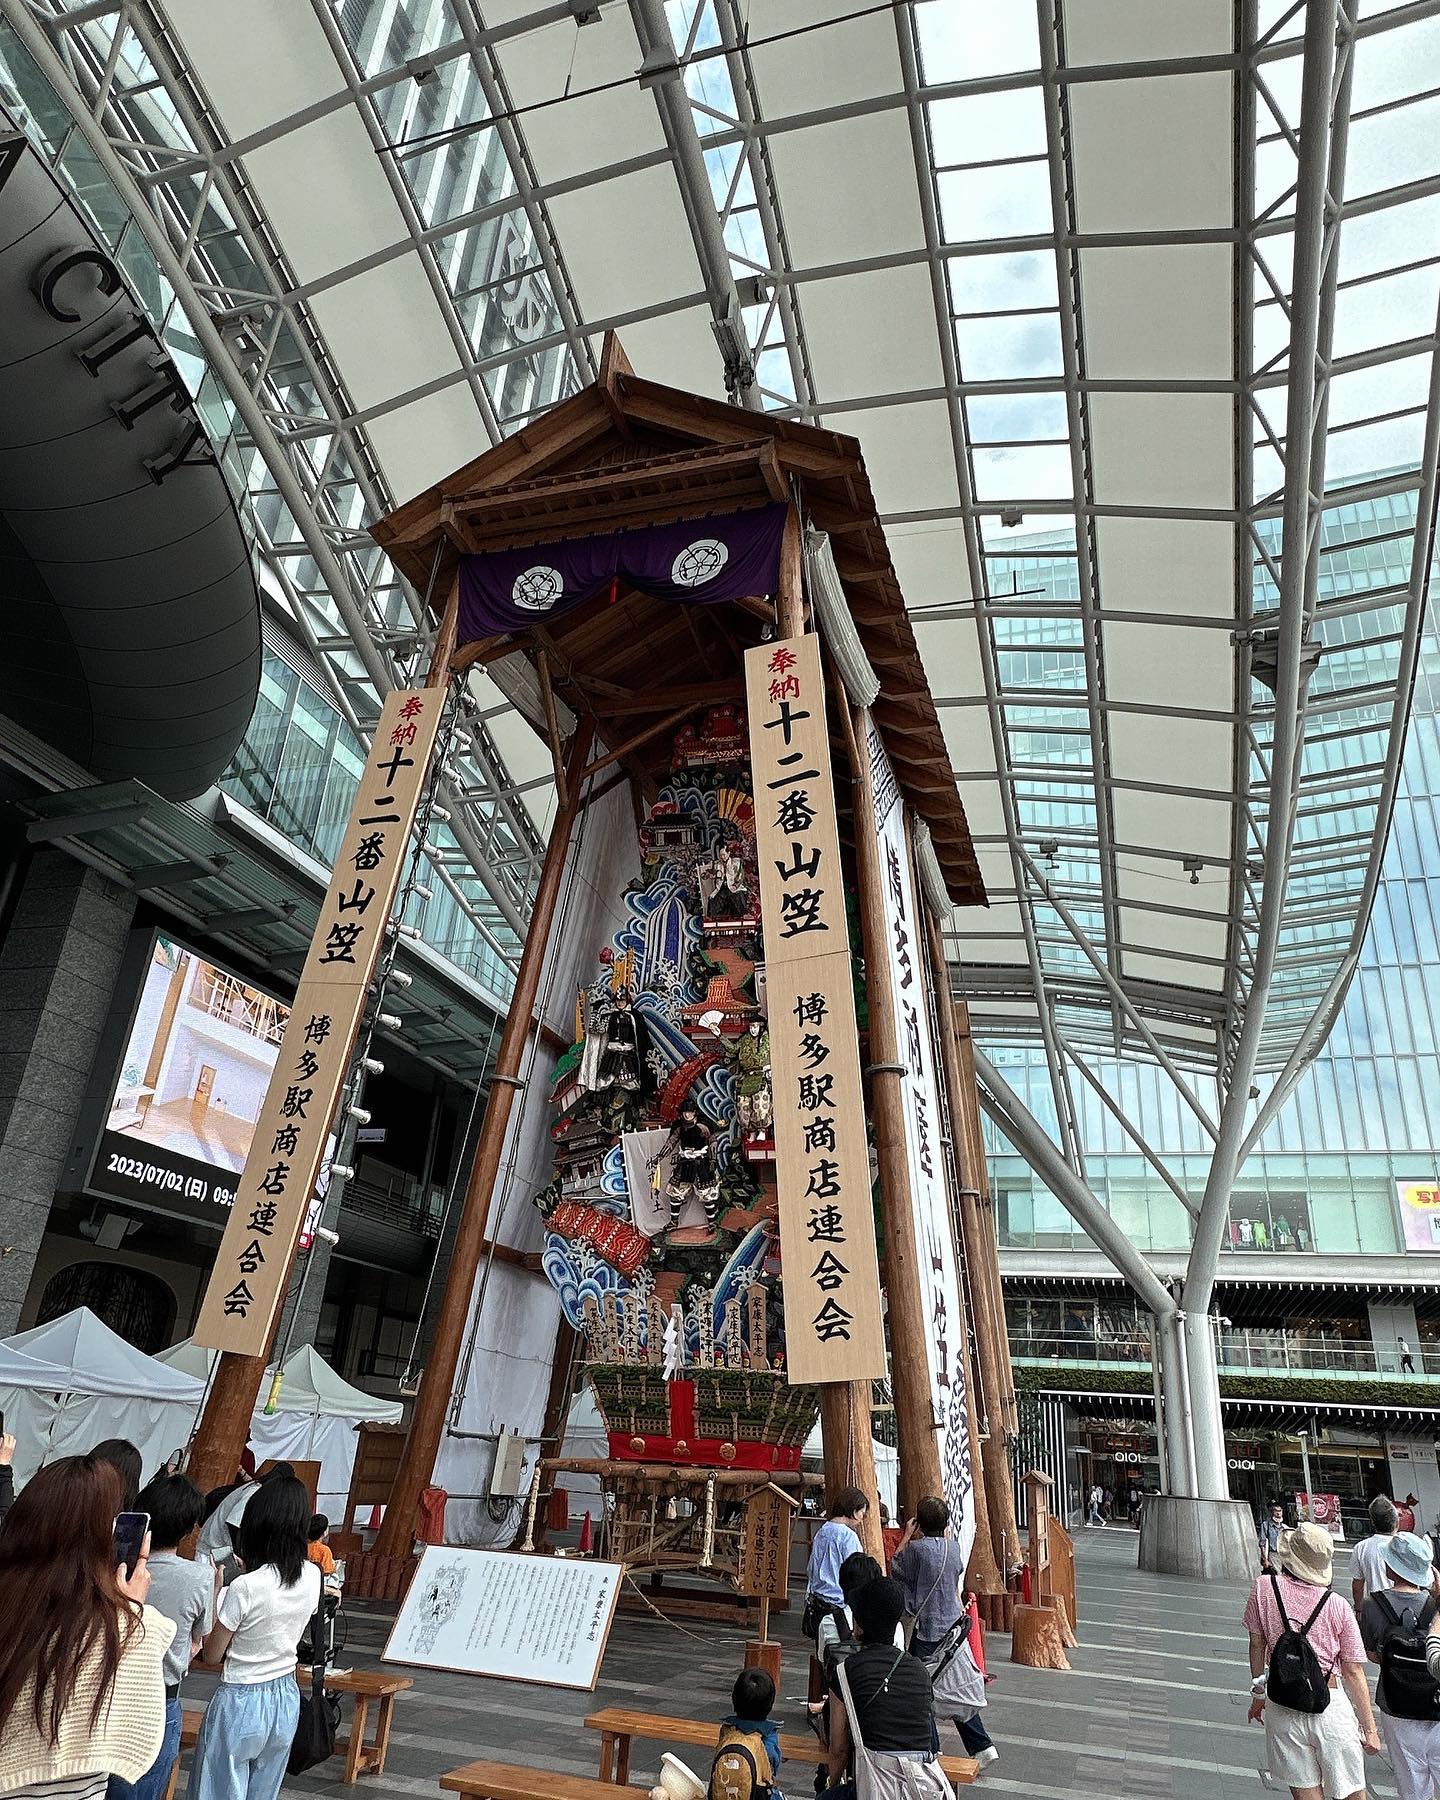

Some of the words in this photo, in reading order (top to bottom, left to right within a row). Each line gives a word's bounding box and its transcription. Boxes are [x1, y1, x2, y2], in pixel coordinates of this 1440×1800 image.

[31, 246, 217, 486] CITY
[223, 1014, 333, 1319] 博多駅商店連合会
[793, 992, 855, 1343] 博多駅商店連合会
